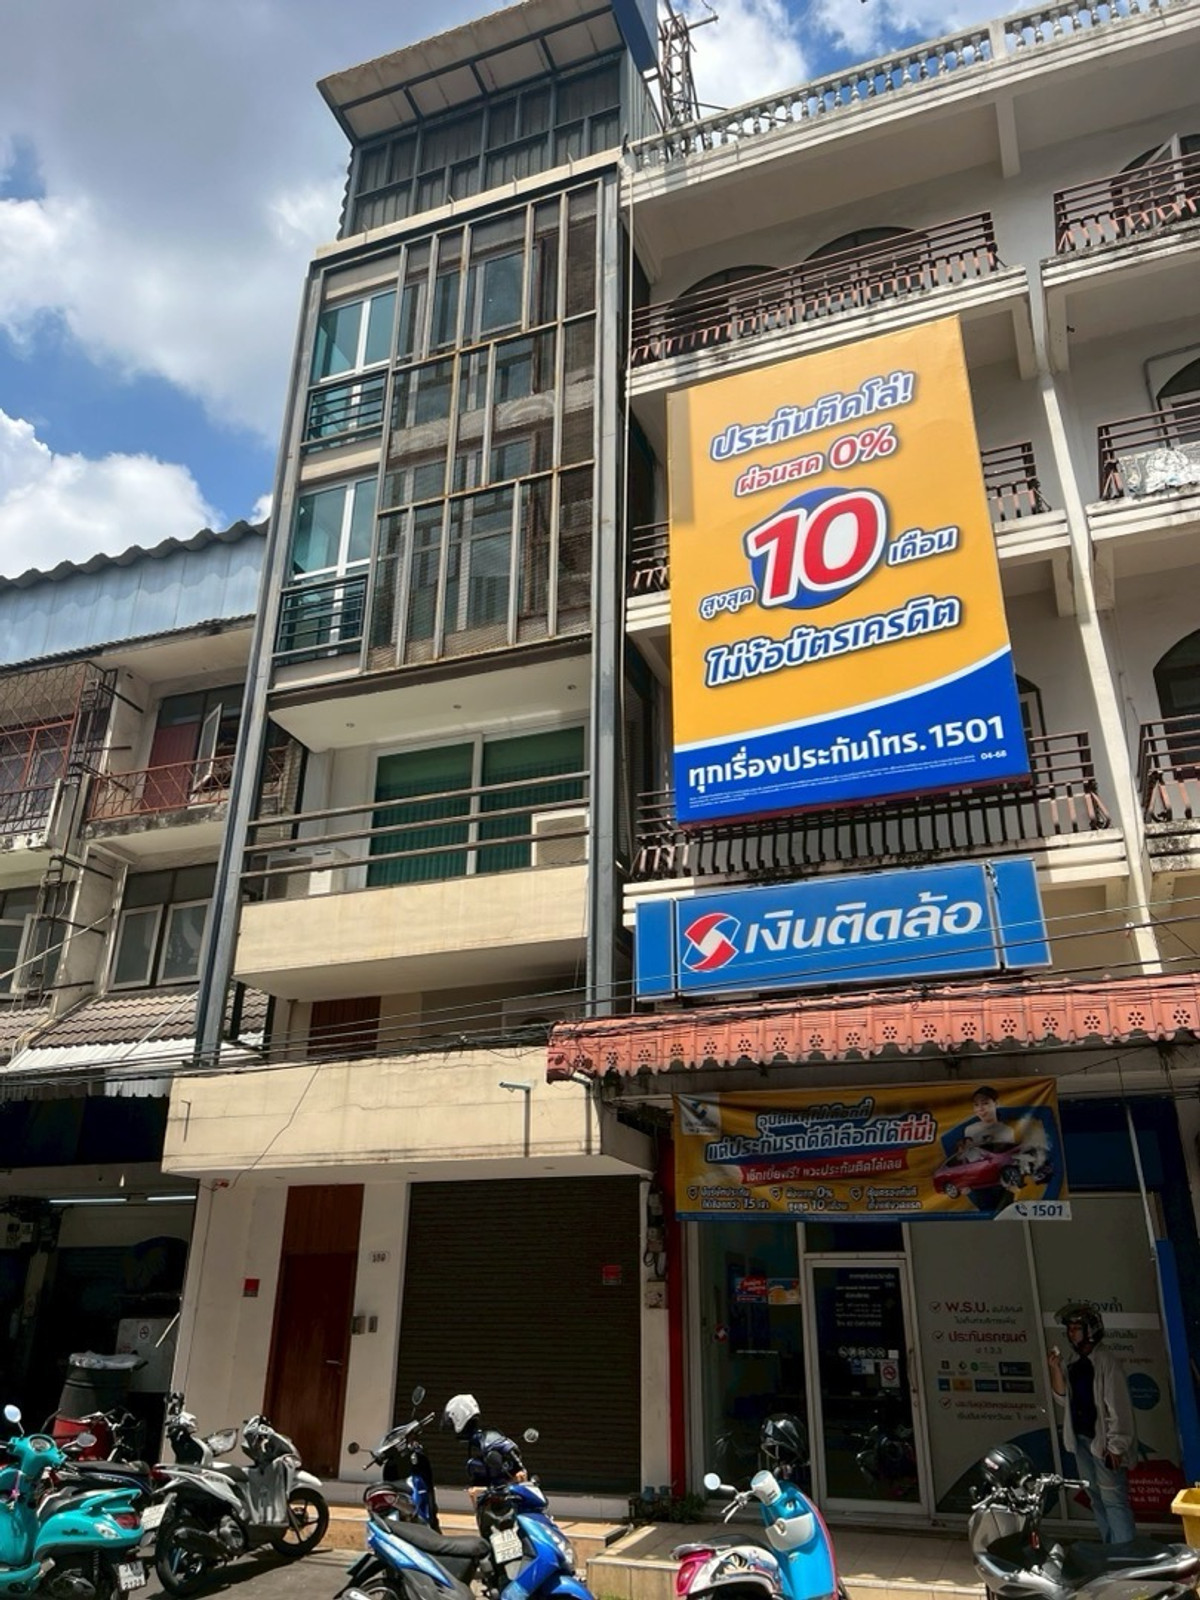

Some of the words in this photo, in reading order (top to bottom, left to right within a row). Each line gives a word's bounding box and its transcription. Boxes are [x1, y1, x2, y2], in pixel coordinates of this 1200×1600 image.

[712, 372, 914, 459] ประกันติดโล่!
[736, 453, 822, 496] ผ่อนสด
[829, 425, 896, 469] 0%
[701, 587, 756, 618] สูงสุด
[749, 492, 883, 605] 10
[889, 529, 958, 566] เดือน
[706, 595, 960, 686] ไม่ง้อบัตรเครดิต
[688, 729, 927, 794] ทุกเรื่องประกันโทร.
[929, 715, 1005, 750] 1501
[745, 892, 983, 954] เงินติดล้อ
[743, 1198, 756, 1209] 15
[811, 1200, 826, 1211] 10
[817, 1186, 834, 1198] 0%
[1032, 1204, 1063, 1216] 1501
